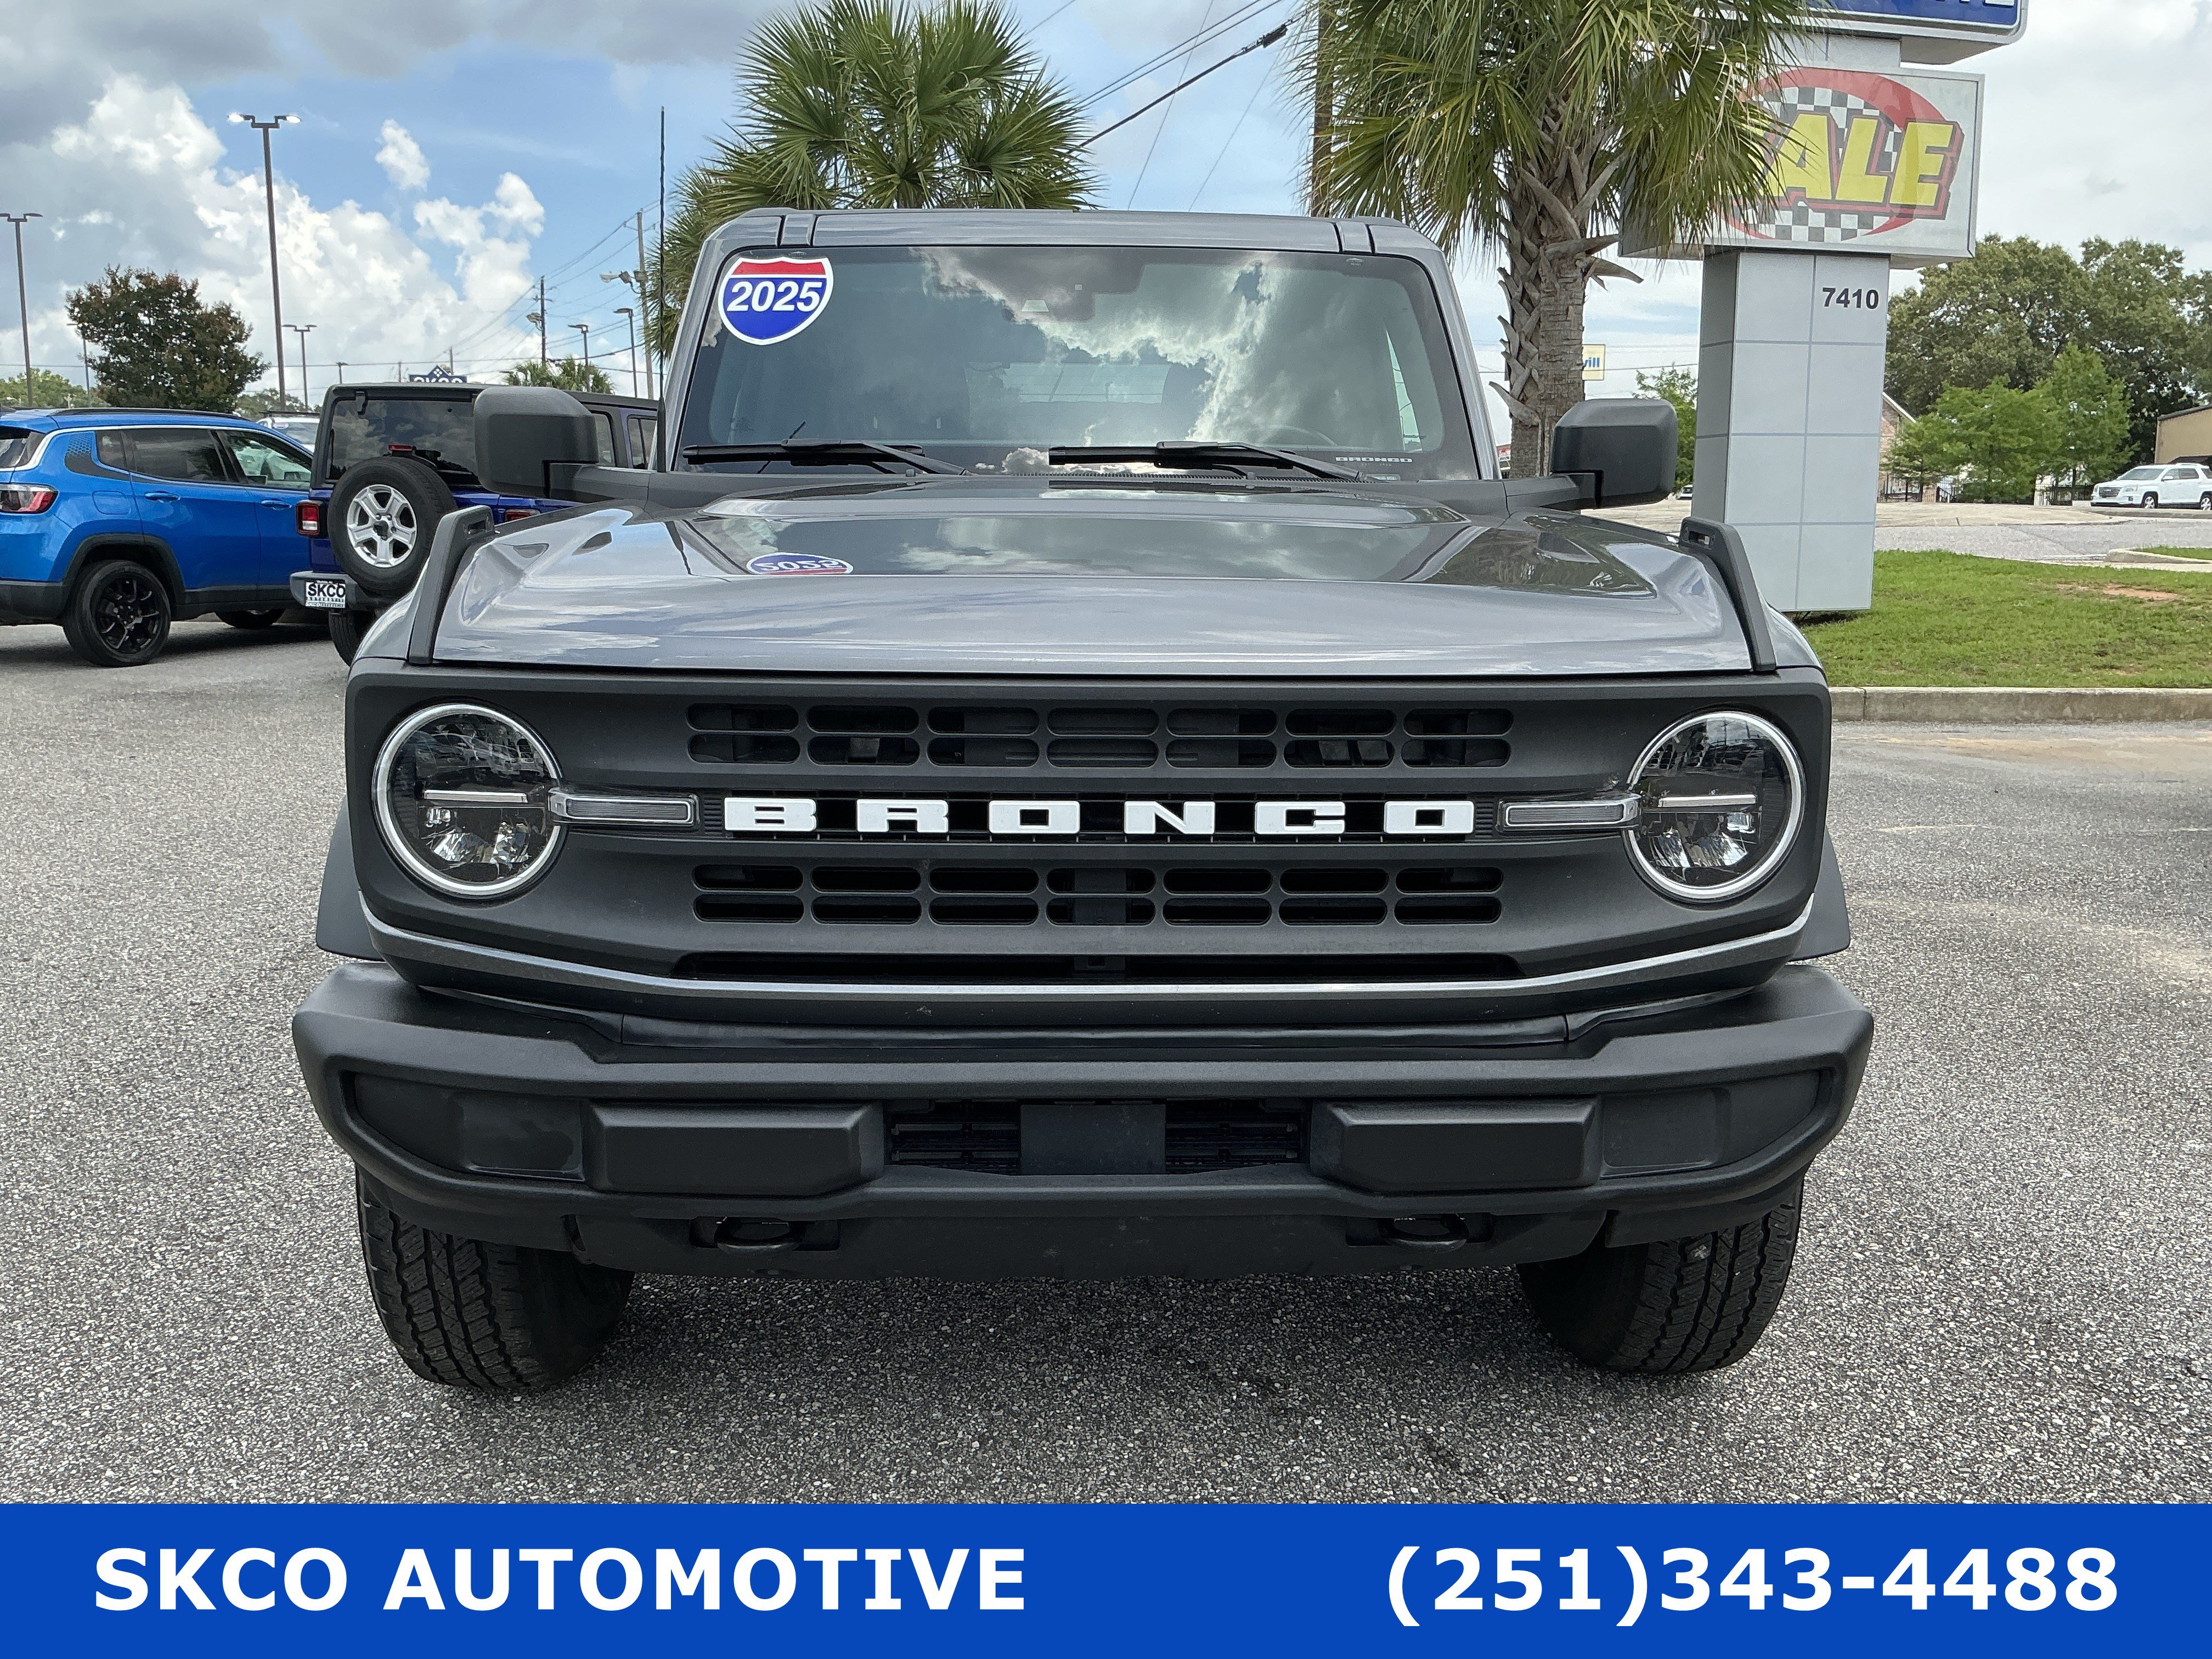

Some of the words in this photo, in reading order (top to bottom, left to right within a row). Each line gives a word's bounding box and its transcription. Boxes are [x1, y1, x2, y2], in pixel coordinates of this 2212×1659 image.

[1718, 112, 1956, 207] ALE
[726, 280, 823, 312] 2025
[1822, 287, 1879, 309] 7410
[307, 583, 346, 598] SKCO
[724, 797, 1474, 834] BRONCO
